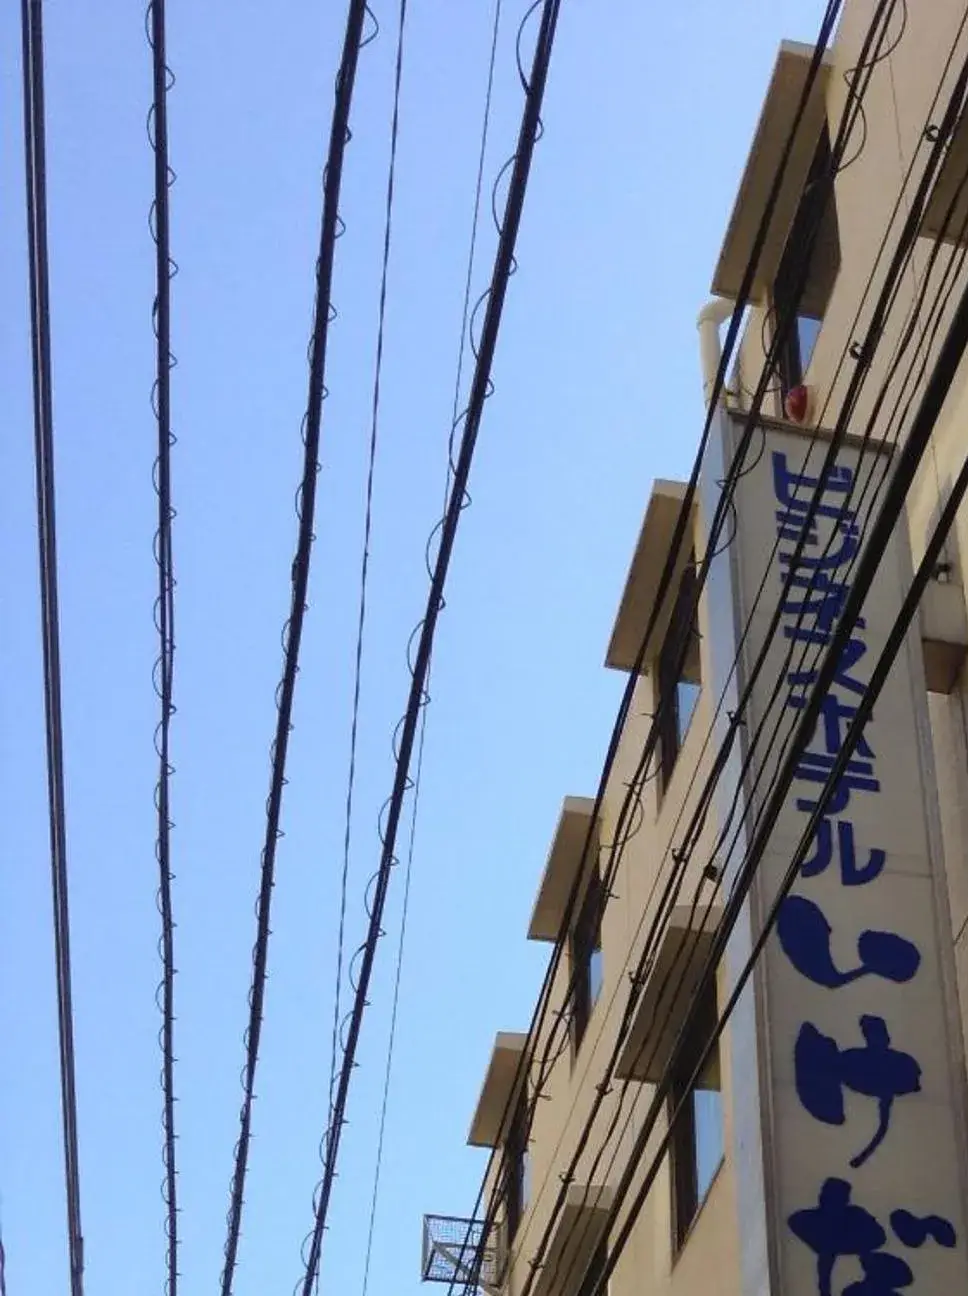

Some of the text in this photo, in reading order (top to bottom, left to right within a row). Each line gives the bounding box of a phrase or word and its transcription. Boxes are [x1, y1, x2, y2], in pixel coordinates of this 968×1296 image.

[772, 451, 887, 886] ビジネスホテル
